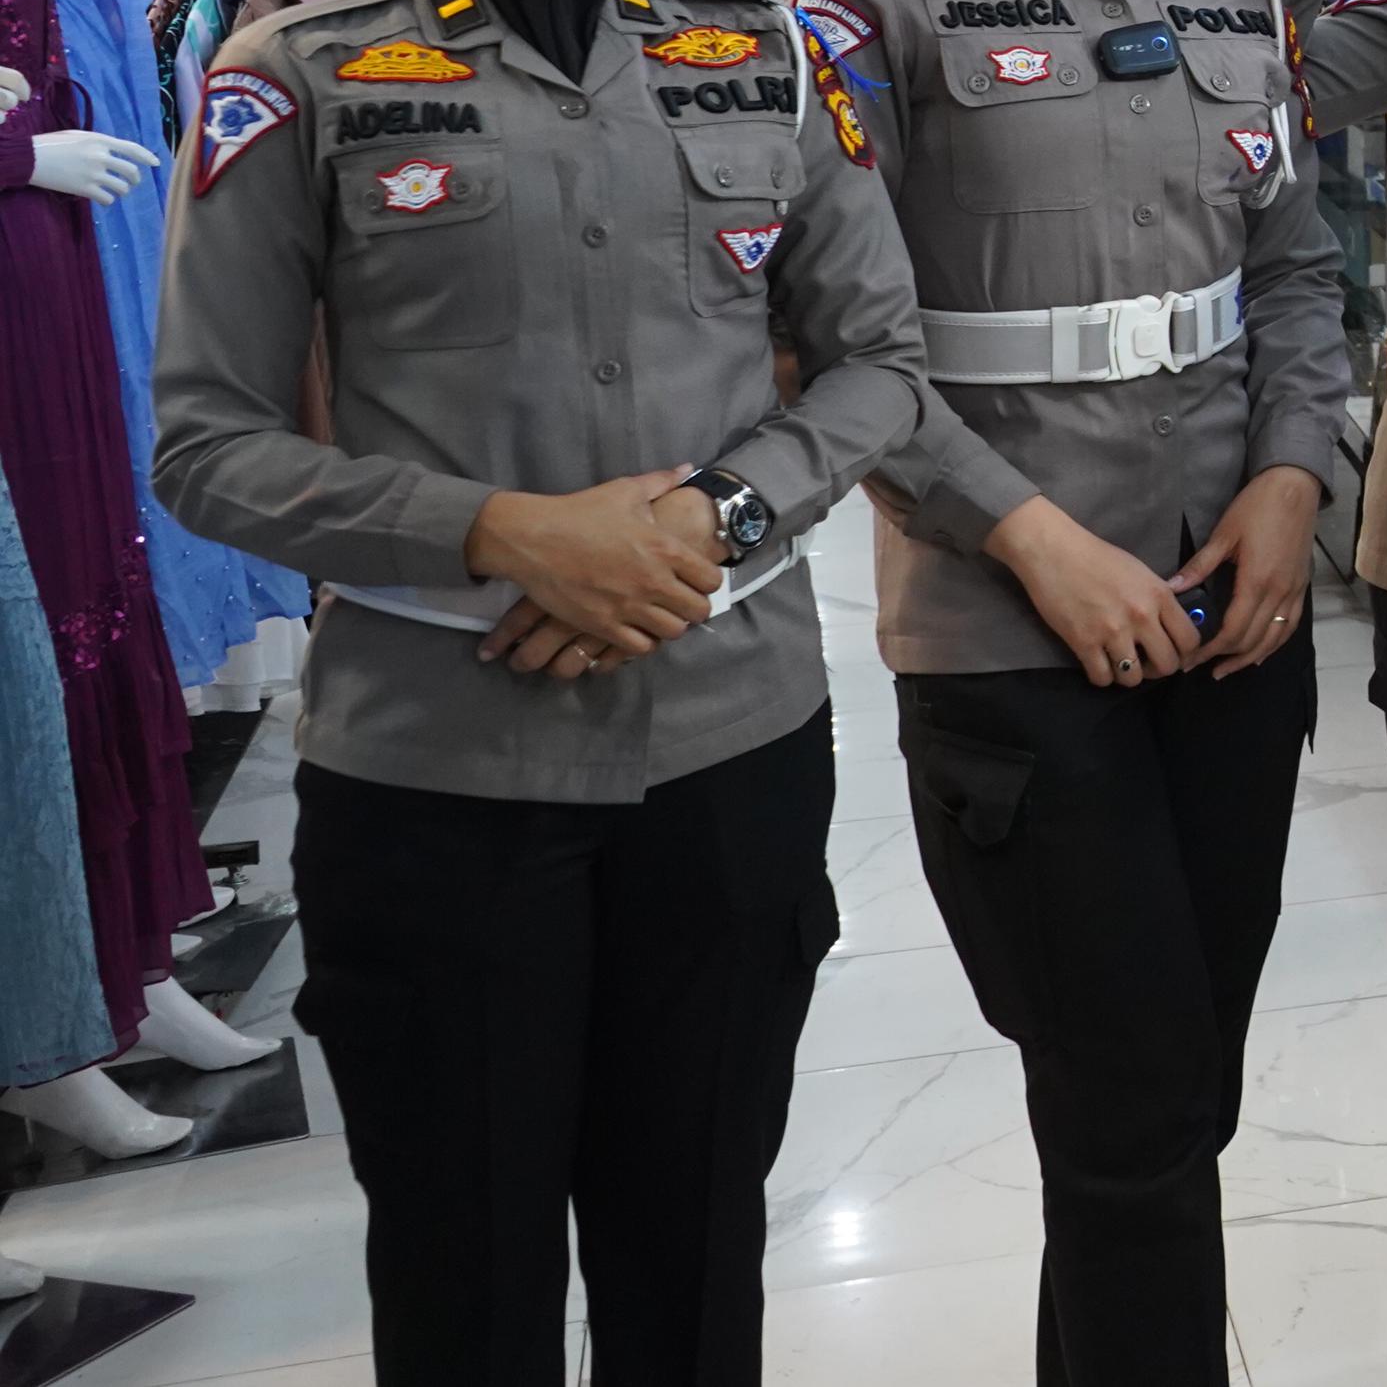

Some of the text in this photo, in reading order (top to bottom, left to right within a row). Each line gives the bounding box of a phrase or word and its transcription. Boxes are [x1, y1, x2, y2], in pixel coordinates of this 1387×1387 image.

[841, 9, 873, 37] LINTAS
[1166, 3, 1277, 39] POLRI
[657, 75, 798, 118] POLRI
[336, 100, 483, 145] ADELINA
